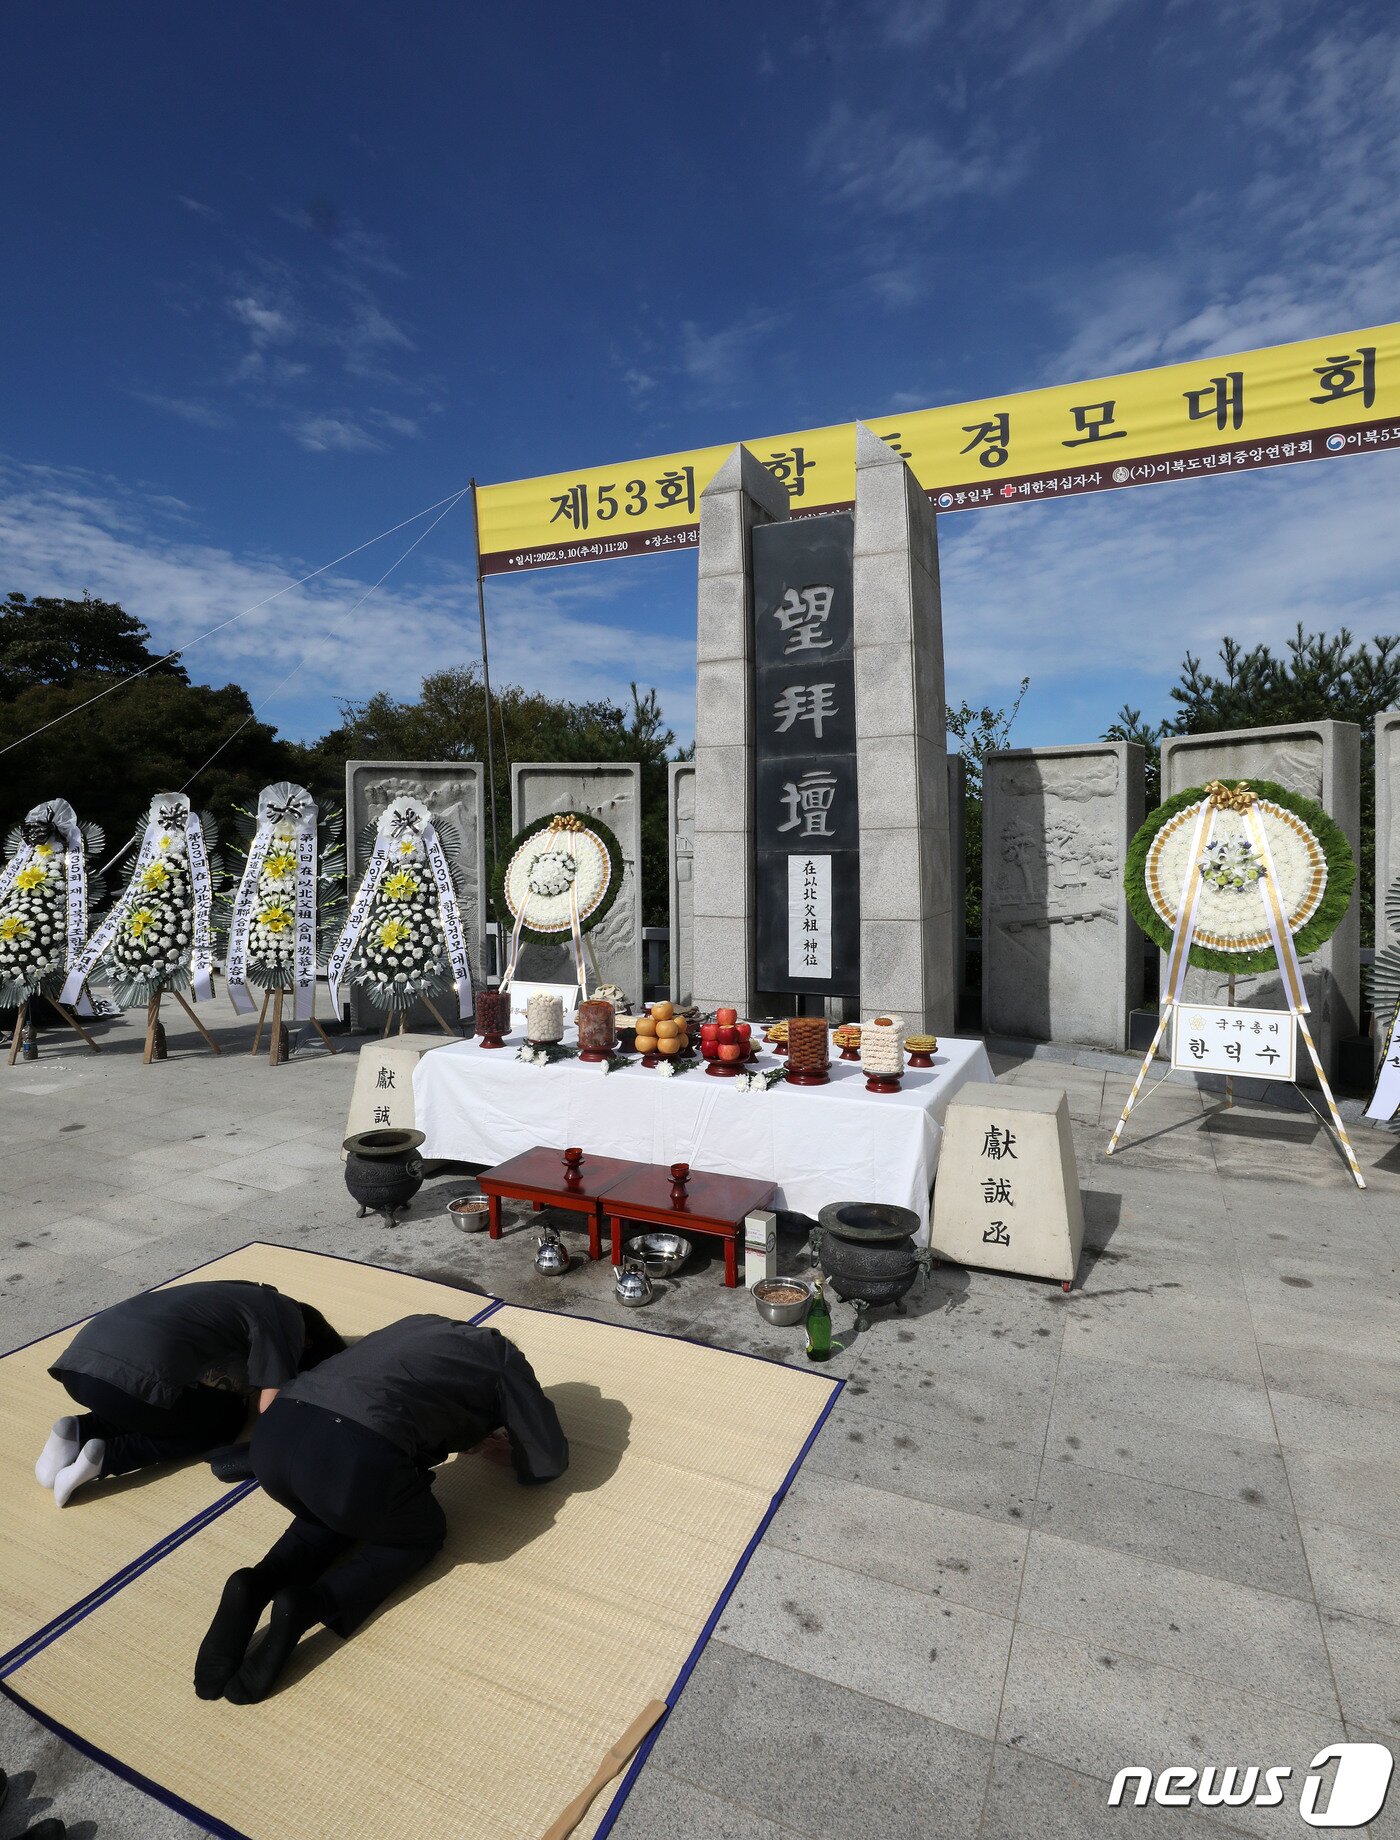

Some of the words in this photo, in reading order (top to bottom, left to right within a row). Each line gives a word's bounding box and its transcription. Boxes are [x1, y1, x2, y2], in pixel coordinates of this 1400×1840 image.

[550, 466, 697, 530] 제53회
[604, 540, 628, 555] 11:20
[651, 529, 700, 548] 장소:임진
[954, 486, 994, 504] 통일부
[1018, 472, 1102, 496] 대한적십자사
[1130, 440, 1313, 480] (사)이북도민회중앙연합회
[429, 843, 449, 894] 제53회
[1188, 1038, 1281, 1066] 한덕수
